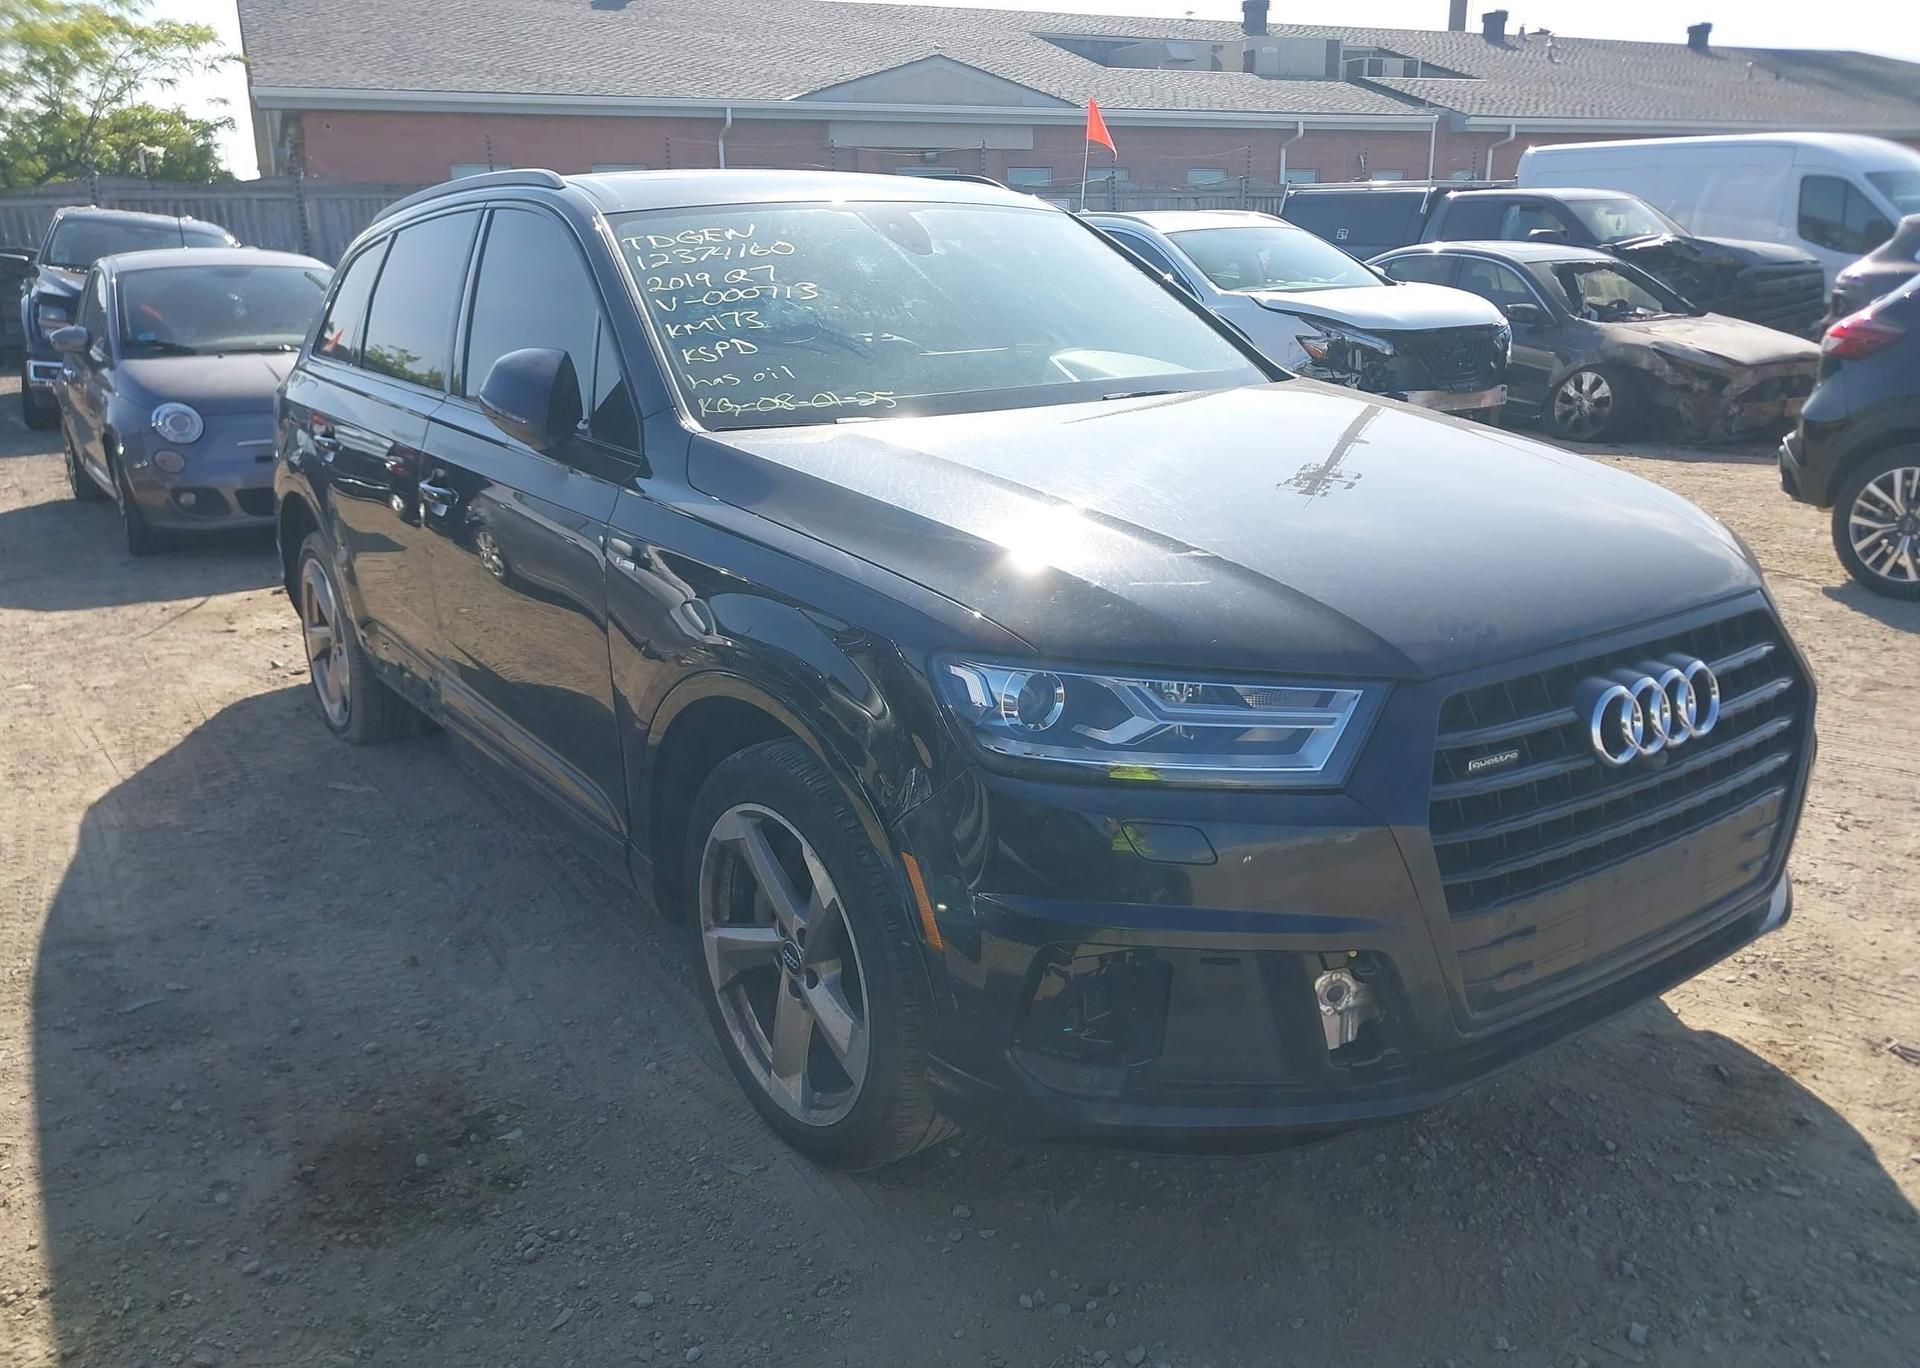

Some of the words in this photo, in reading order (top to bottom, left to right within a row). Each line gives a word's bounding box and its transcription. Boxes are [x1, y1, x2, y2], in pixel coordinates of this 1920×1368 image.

[621, 223, 755, 251] TDGEN
[647, 272, 712, 293] 2019
[724, 264, 775, 284] Q7
[655, 282, 819, 312] V-000713
[681, 338, 759, 365] KSPD
[686, 372, 740, 389] has
[753, 365, 796, 382] oil
[1469, 750, 1519, 771] quattro
